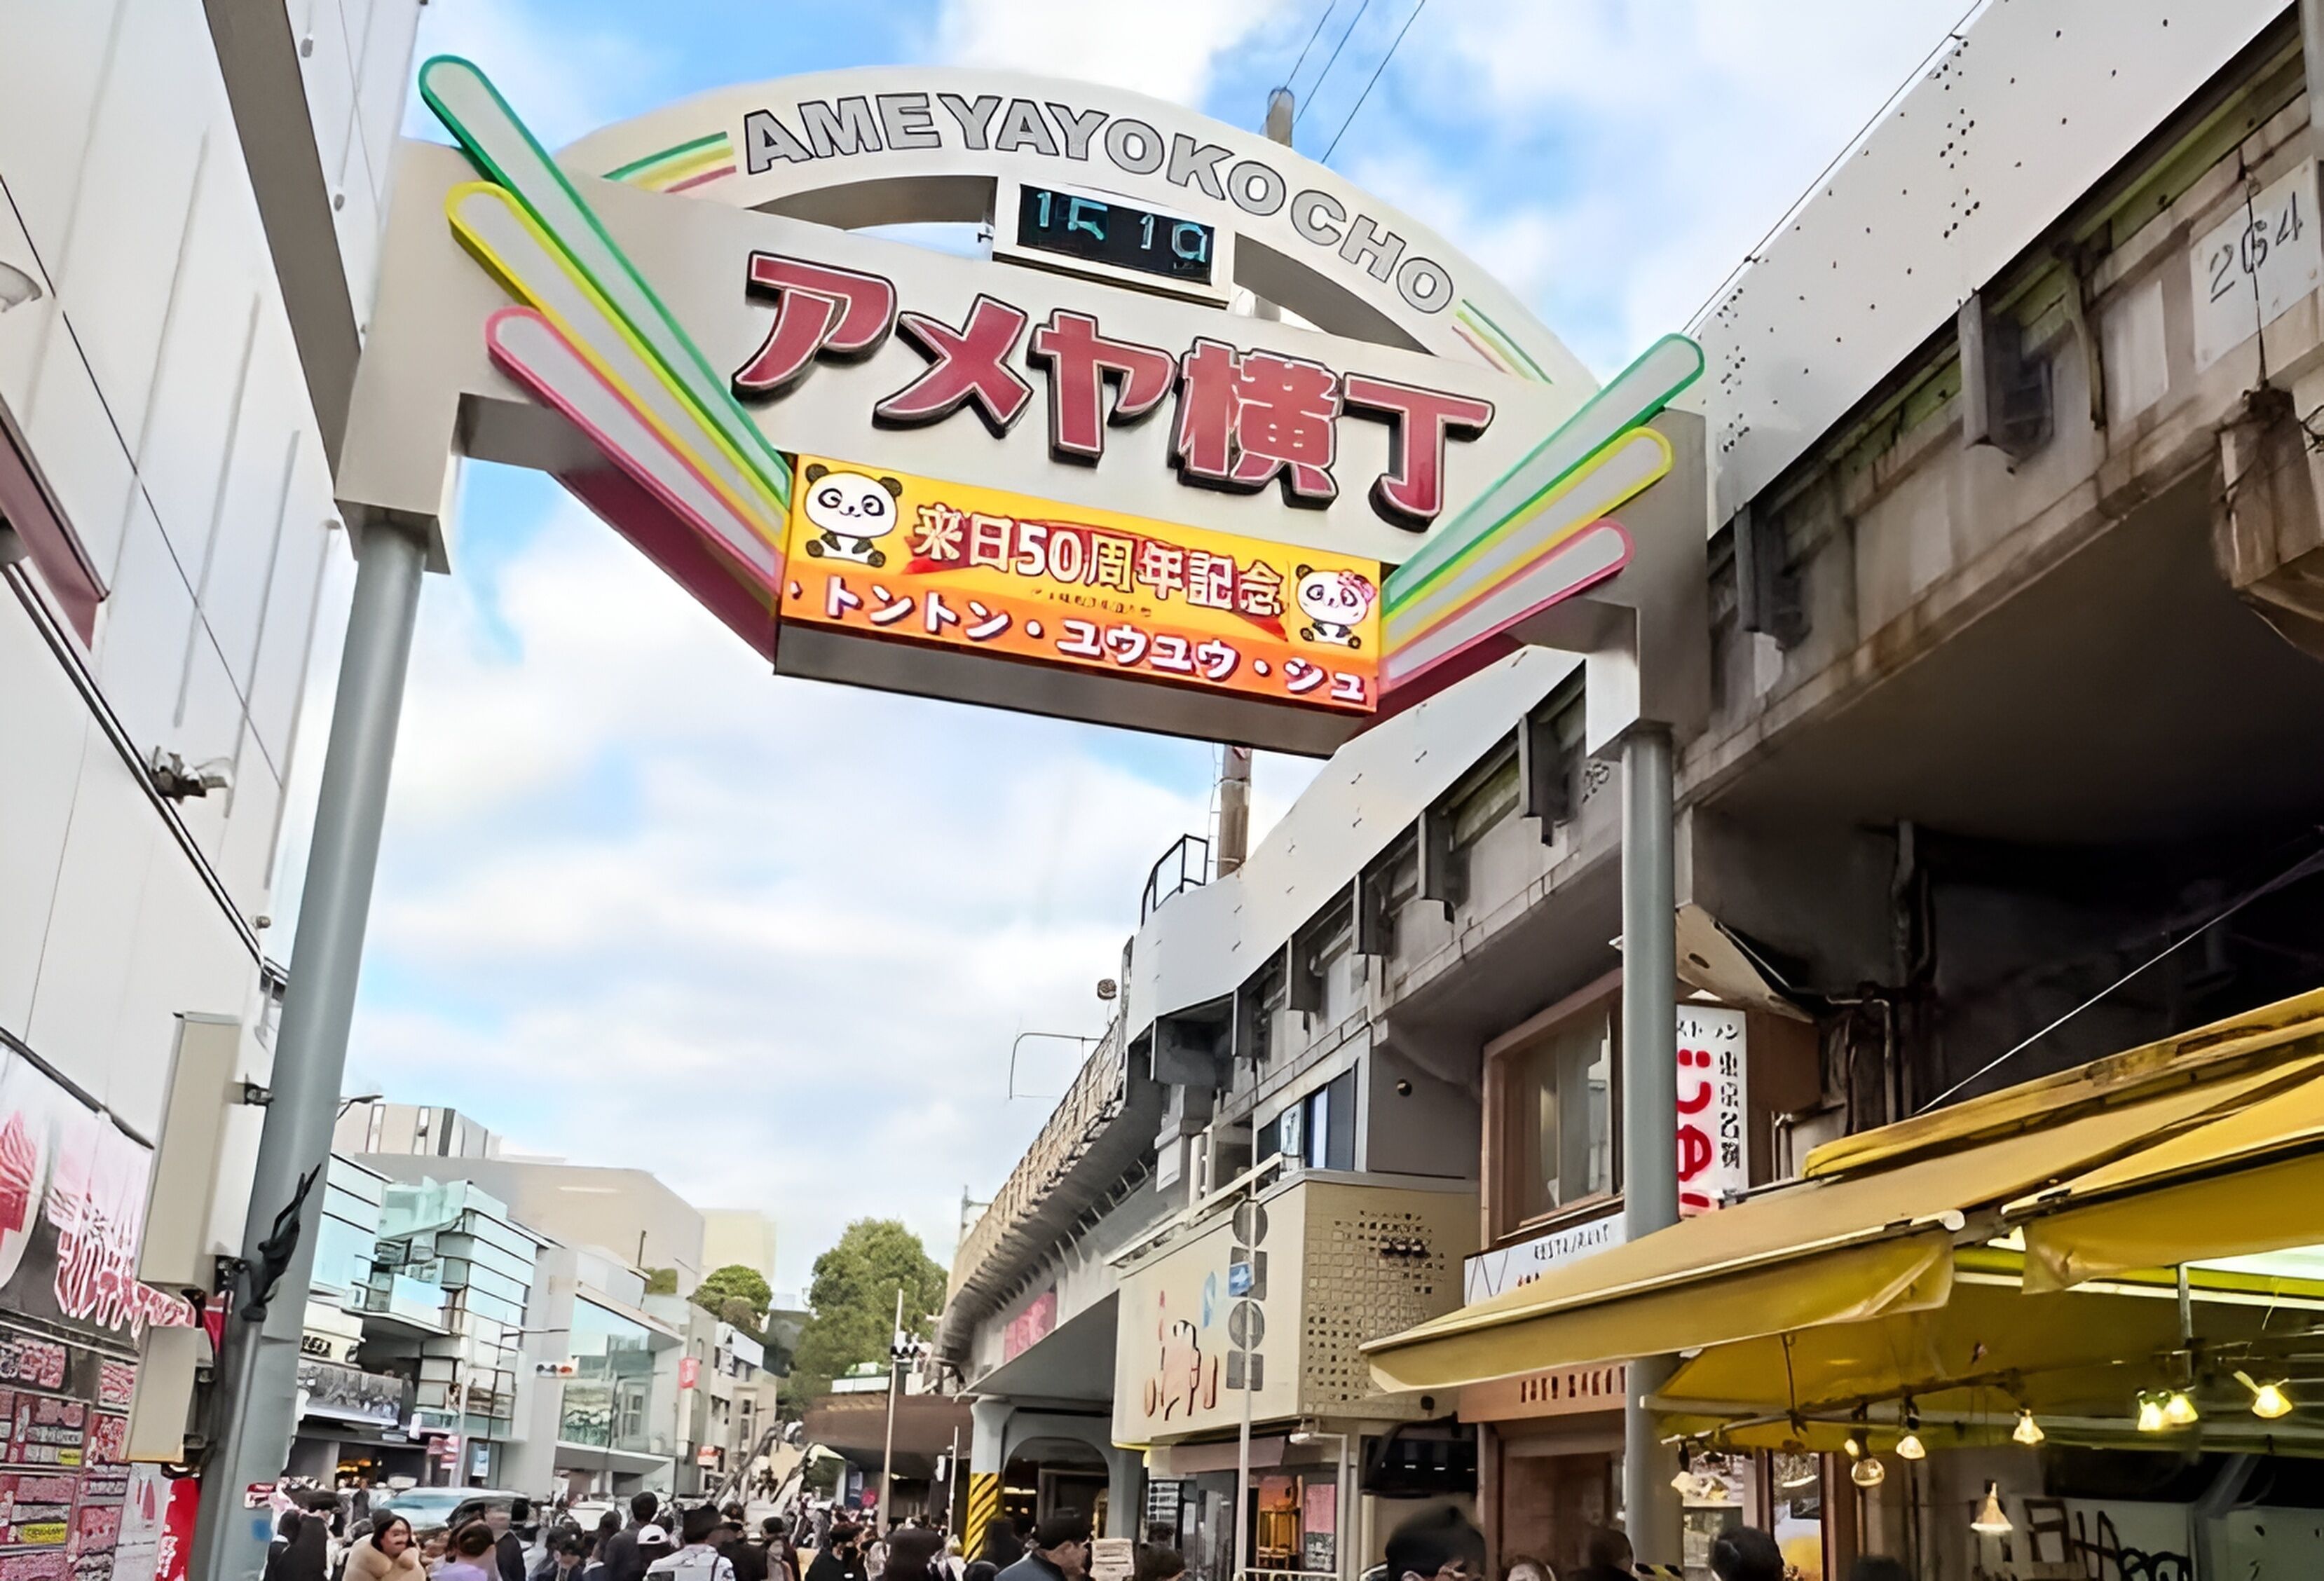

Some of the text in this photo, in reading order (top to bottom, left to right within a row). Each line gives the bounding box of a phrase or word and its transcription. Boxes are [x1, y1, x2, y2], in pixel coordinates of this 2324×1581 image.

[744, 92, 1454, 313] AMEYAYOKOCHO
[732, 249, 1496, 533] アメヤ横丁
[913, 502, 1285, 617] 来日50周年記念
